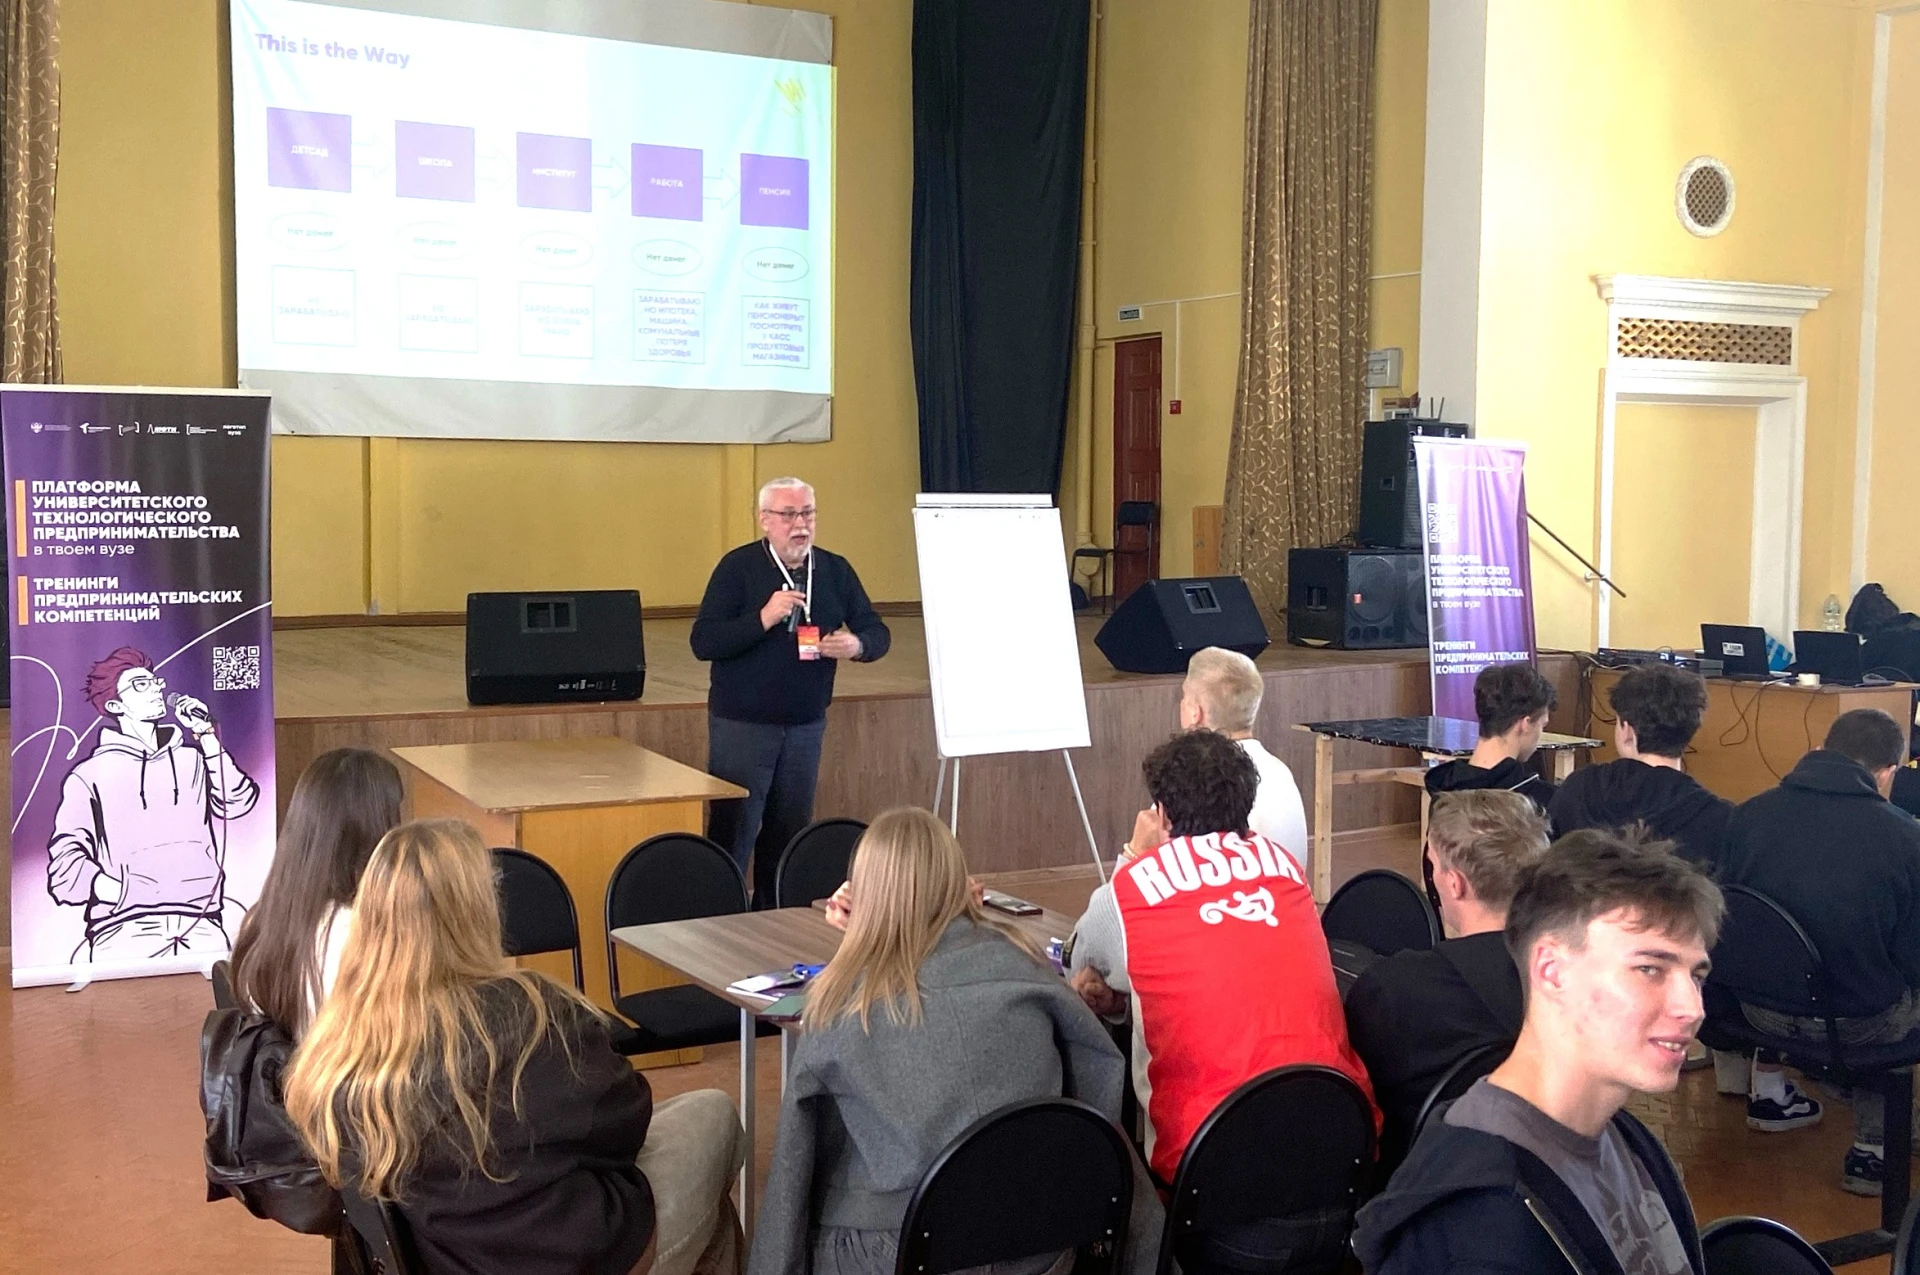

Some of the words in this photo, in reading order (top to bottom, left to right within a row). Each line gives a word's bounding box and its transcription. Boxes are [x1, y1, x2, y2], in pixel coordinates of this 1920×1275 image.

[254, 33, 298, 53] This
[302, 37, 319, 56] is
[324, 41, 359, 60] the
[363, 45, 411, 69] Way
[290, 144, 330, 159] ДЕТСАД
[418, 156, 453, 168] ШКОЛА
[532, 167, 577, 179] ИНСТИТУТ
[650, 177, 684, 188] РАБОТА
[758, 187, 792, 197] ПЕНСИЯ
[756, 260, 771, 269] Нет
[32, 480, 141, 494] ПЛАТФОРМА
[32, 496, 208, 510] УНИВЕРСИТЕТСКОГО
[32, 511, 212, 525] ТЕХНОЛОГИЧЕСКОГО
[33, 526, 240, 542] ПРЕДПРИНИМАТЕЛЬСТВА
[34, 545, 43, 555] в
[46, 544, 96, 555] твоем
[100, 544, 135, 557] вузе
[33, 576, 119, 591] ТРЕНИНГИ
[34, 590, 243, 609] ПРЕДПРИНИМАТЕЛЬСКИХ
[34, 605, 160, 624] КОМПЕТЕНЦИЙ
[1433, 641, 1476, 651] ТРЕНИНГИ
[1435, 651, 1530, 664] ПРЕДПРИНИМАТЕЛЬСКИХ
[1128, 831, 1306, 907] RUSSIA
